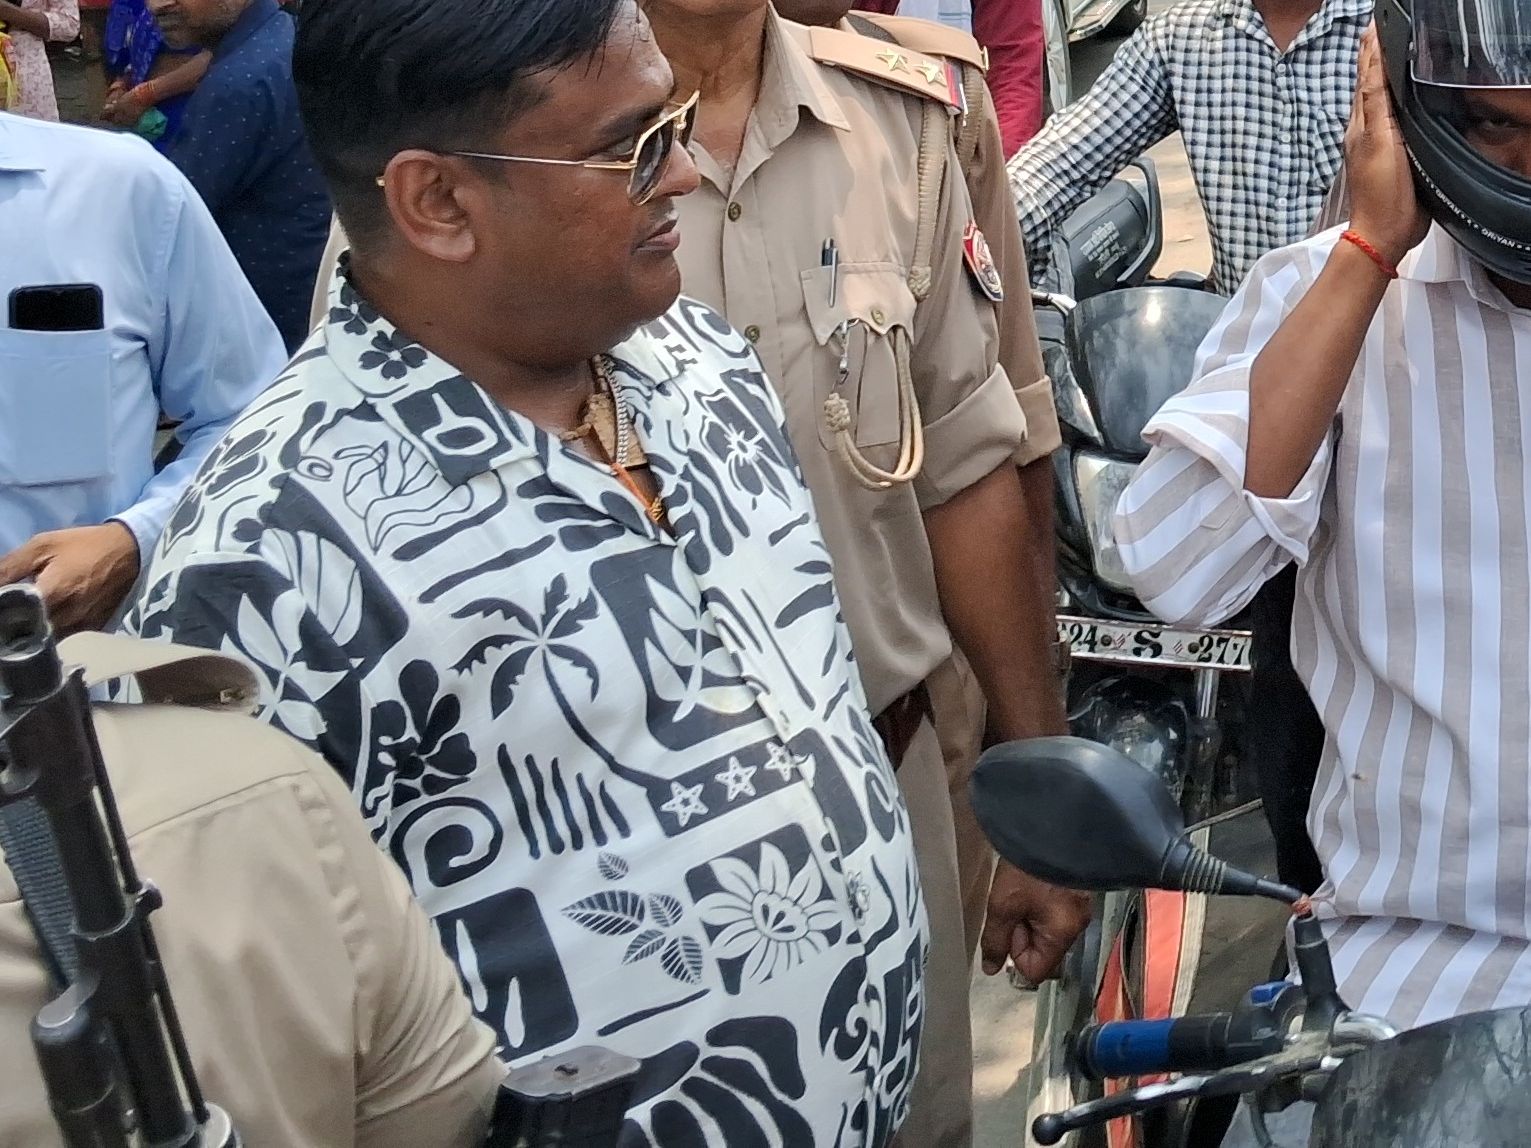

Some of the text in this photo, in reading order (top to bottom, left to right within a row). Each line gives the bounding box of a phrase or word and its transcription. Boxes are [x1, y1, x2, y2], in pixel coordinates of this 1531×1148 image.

[1057, 622, 1251, 666] 24 S 277
